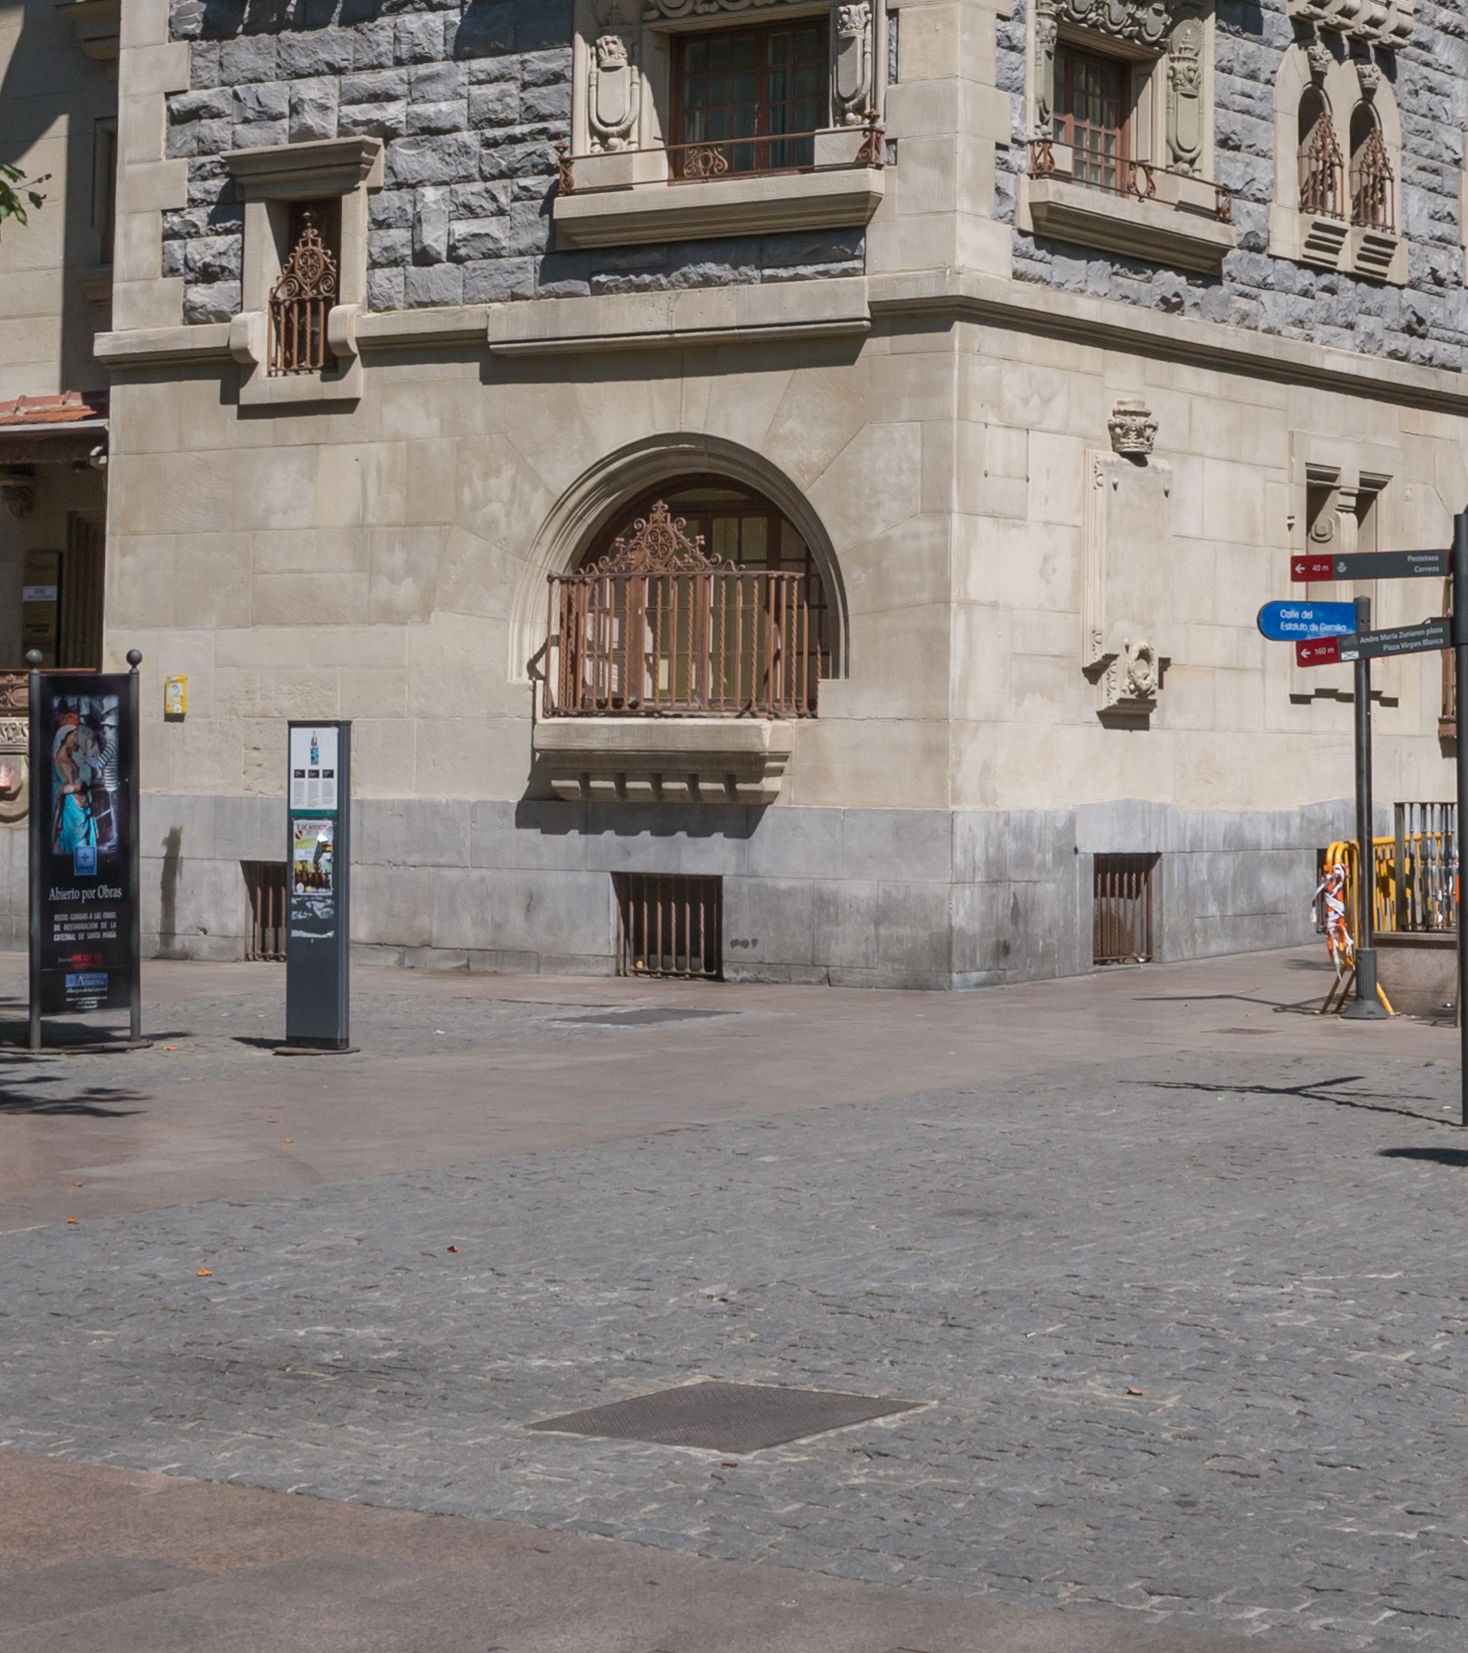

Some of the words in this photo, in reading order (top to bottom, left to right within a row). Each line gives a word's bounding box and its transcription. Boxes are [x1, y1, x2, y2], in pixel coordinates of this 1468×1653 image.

[1312, 564, 1321, 572] 40
[1414, 565, 1440, 573] Correos
[1279, 609, 1299, 619] Calle
[1301, 610, 1313, 619] del
[1280, 622, 1307, 631] Estatuto
[1309, 623, 1318, 631] de
[1319, 623, 1347, 632] Gernika
[1360, 636, 1379, 644] Andre
[1426, 627, 1443, 636] plaza
[1383, 643, 1400, 651] Plaza
[1401, 641, 1421, 650] Virgen
[1423, 638, 1443, 646] Blanca
[49, 886, 80, 901] Abierto
[81, 889, 96, 904] por
[97, 884, 122, 899] Obras
